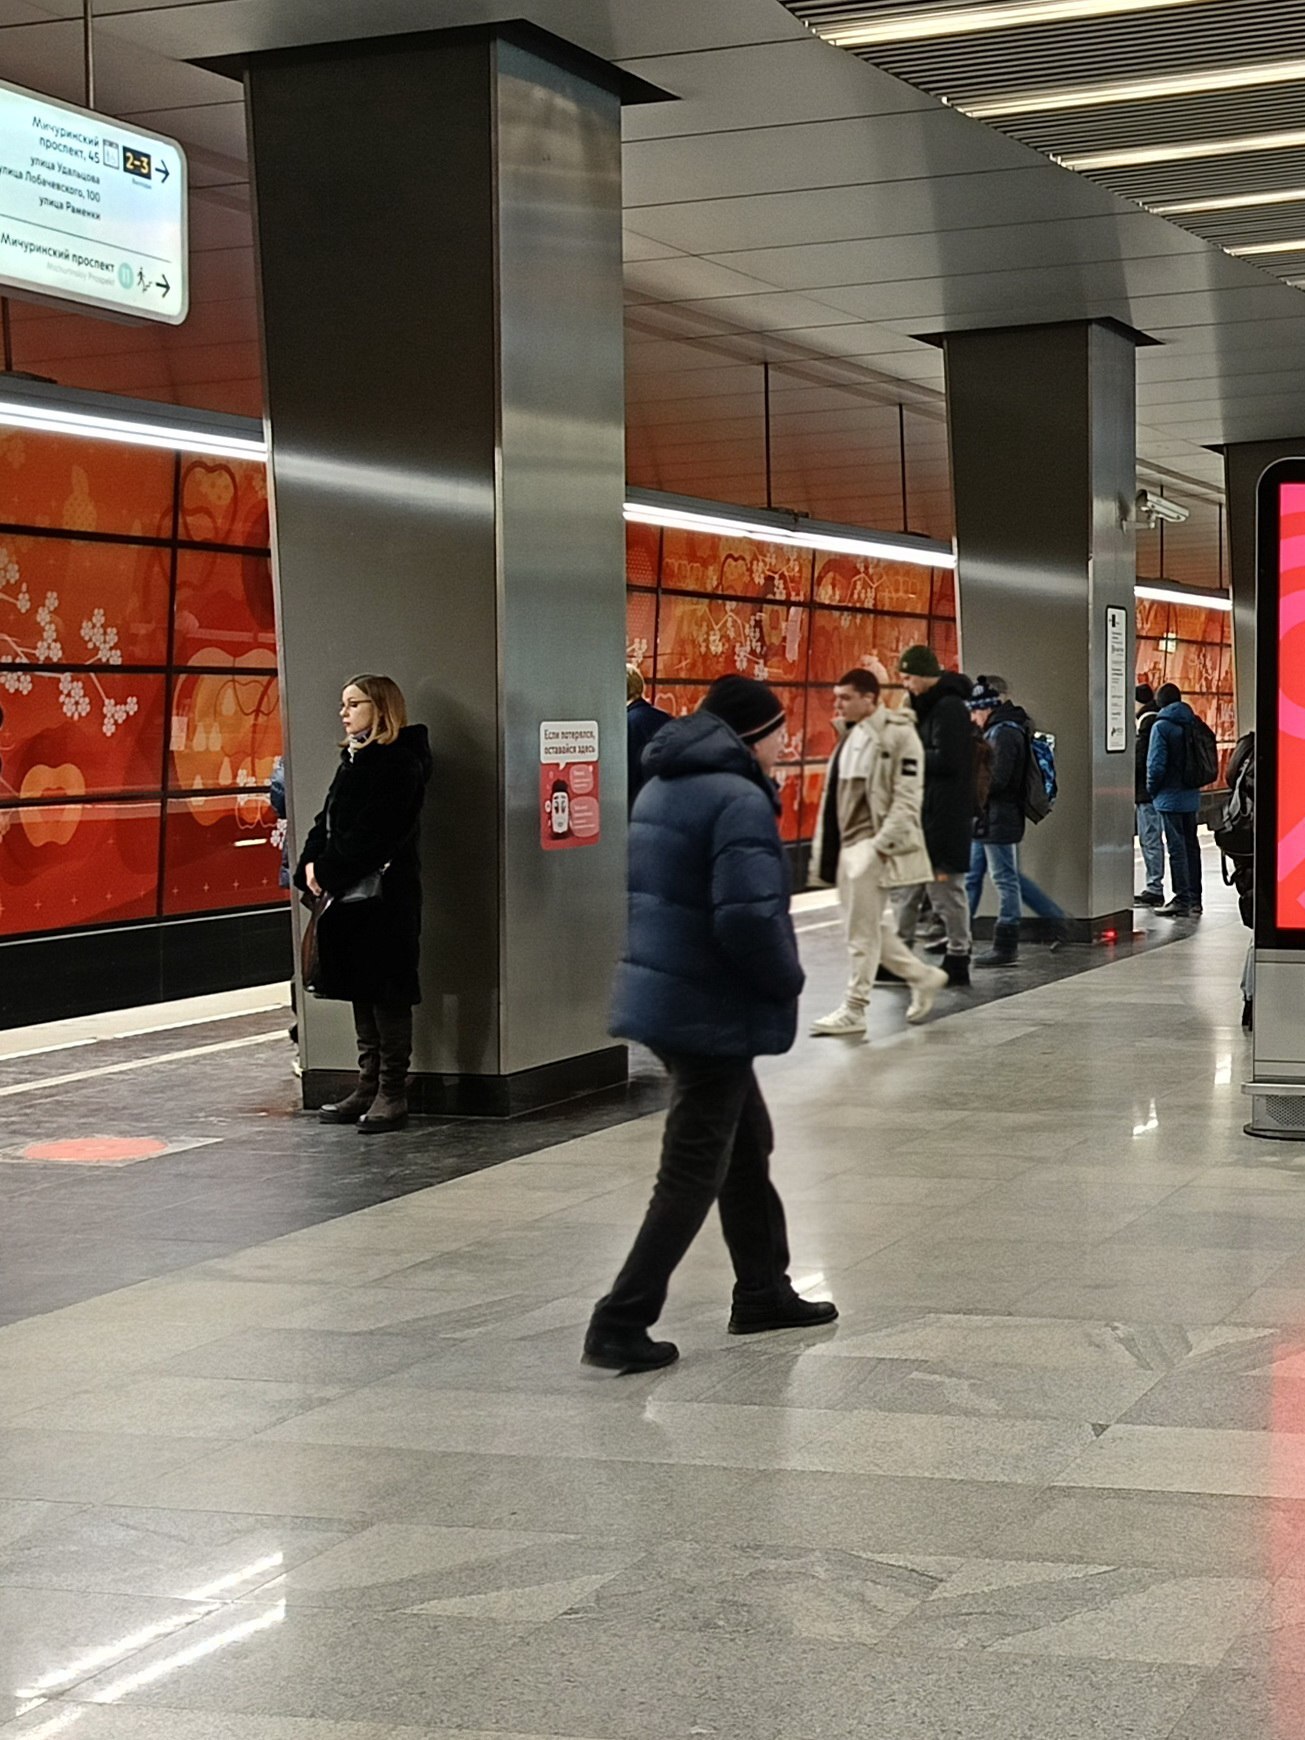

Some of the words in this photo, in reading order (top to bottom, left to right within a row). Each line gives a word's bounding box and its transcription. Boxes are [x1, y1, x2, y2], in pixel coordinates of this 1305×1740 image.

[32, 116, 100, 146] Мичуринский
[39, 137, 87, 160] проспект,
[88, 150, 100, 164] 45
[30, 156, 55, 171] улица
[57, 162, 100, 184] Удальцова
[25, 171, 85, 199] Лобачевского,
[86, 189, 100, 203] 100
[39, 196, 64, 210] улица
[65, 201, 101, 220] Раменки
[0, 233, 70, 260] Мичуринский
[72, 253, 114, 272] проспект
[544, 729, 560, 740] Если
[544, 743, 576, 754] оставайся
[578, 745, 596, 755] здесь
